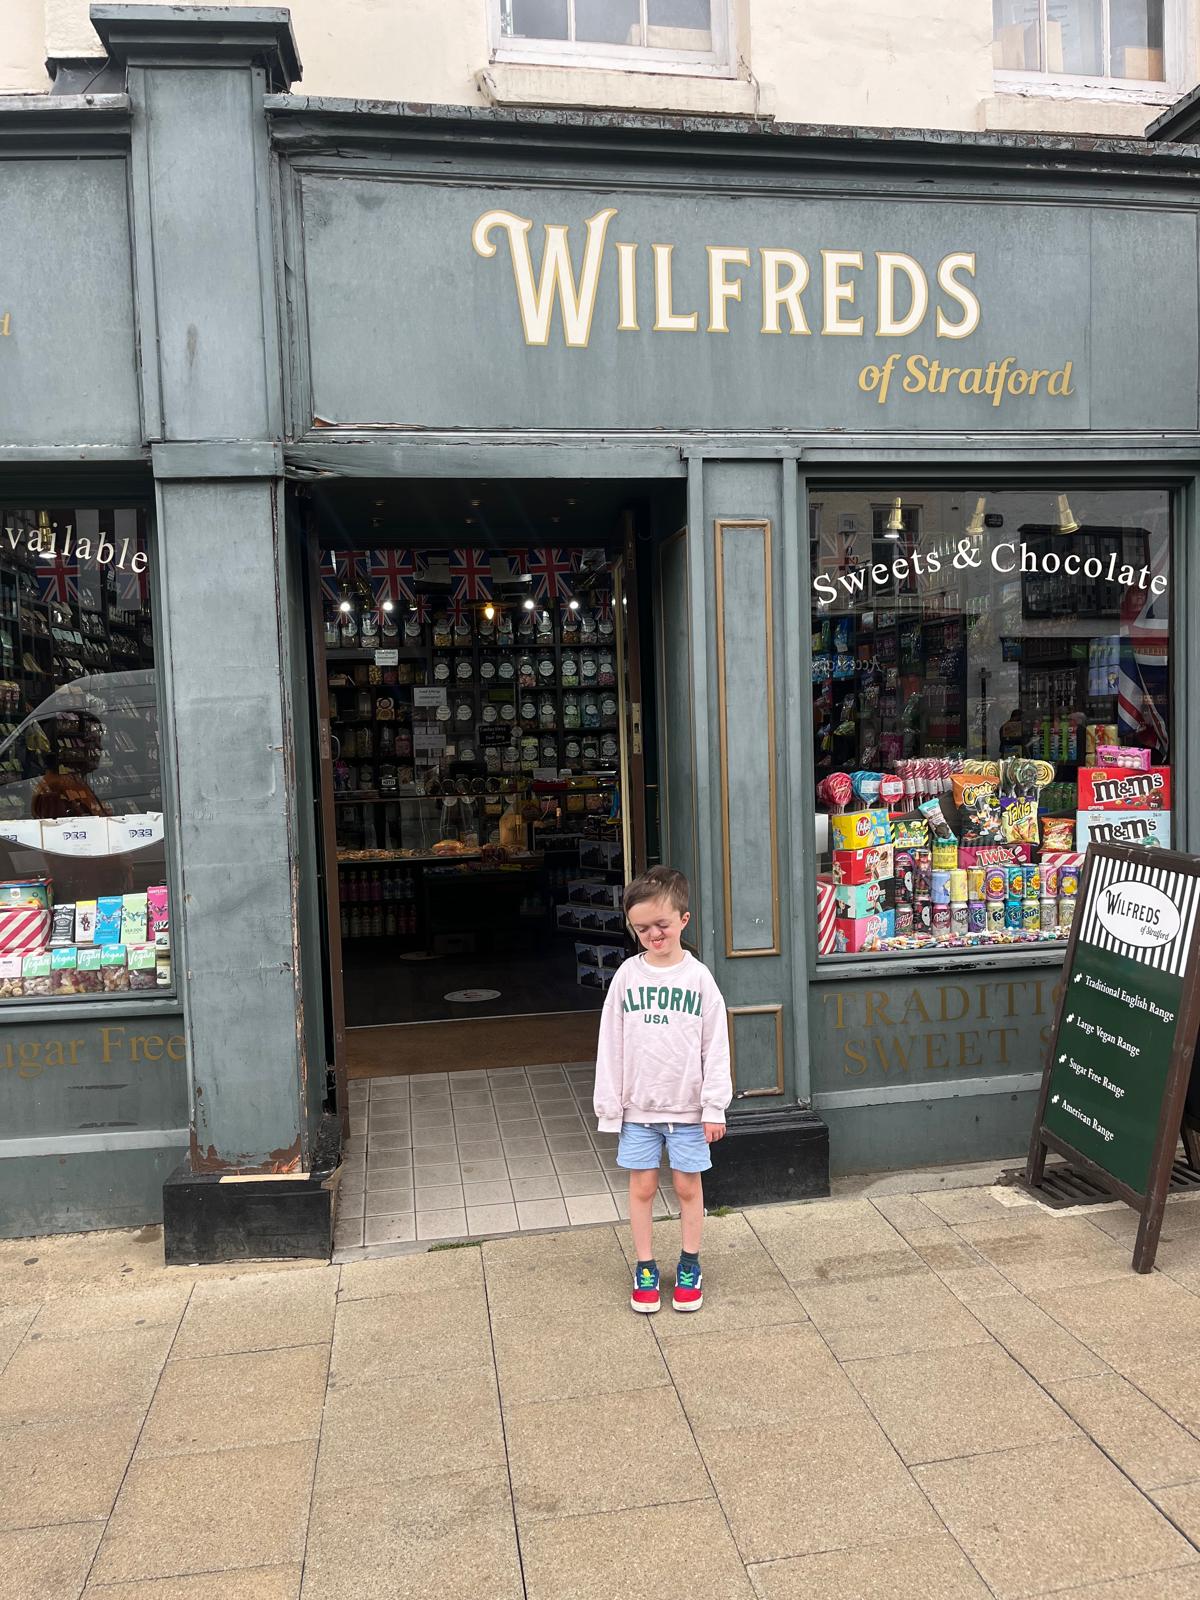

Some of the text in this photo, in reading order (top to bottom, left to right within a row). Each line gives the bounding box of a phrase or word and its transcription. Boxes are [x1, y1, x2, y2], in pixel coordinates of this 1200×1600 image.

[472, 208, 981, 347] WILFREDS
[859, 354, 1075, 406] of Stratford
[0, 522, 148, 574] vailable
[813, 538, 1168, 606] Sweets & Chocolate
[1106, 890, 1160, 925] WILFREDS
[644, 1014, 669, 1024] USA
[1085, 975, 1174, 1023] Traditional English Range
[98, 1026, 186, 1063] Free
[1076, 1016, 1140, 1057] Large Vegan Range
[1069, 1057, 1125, 1098] Sugar Free Range
[1061, 1099, 1114, 1141] American Range
